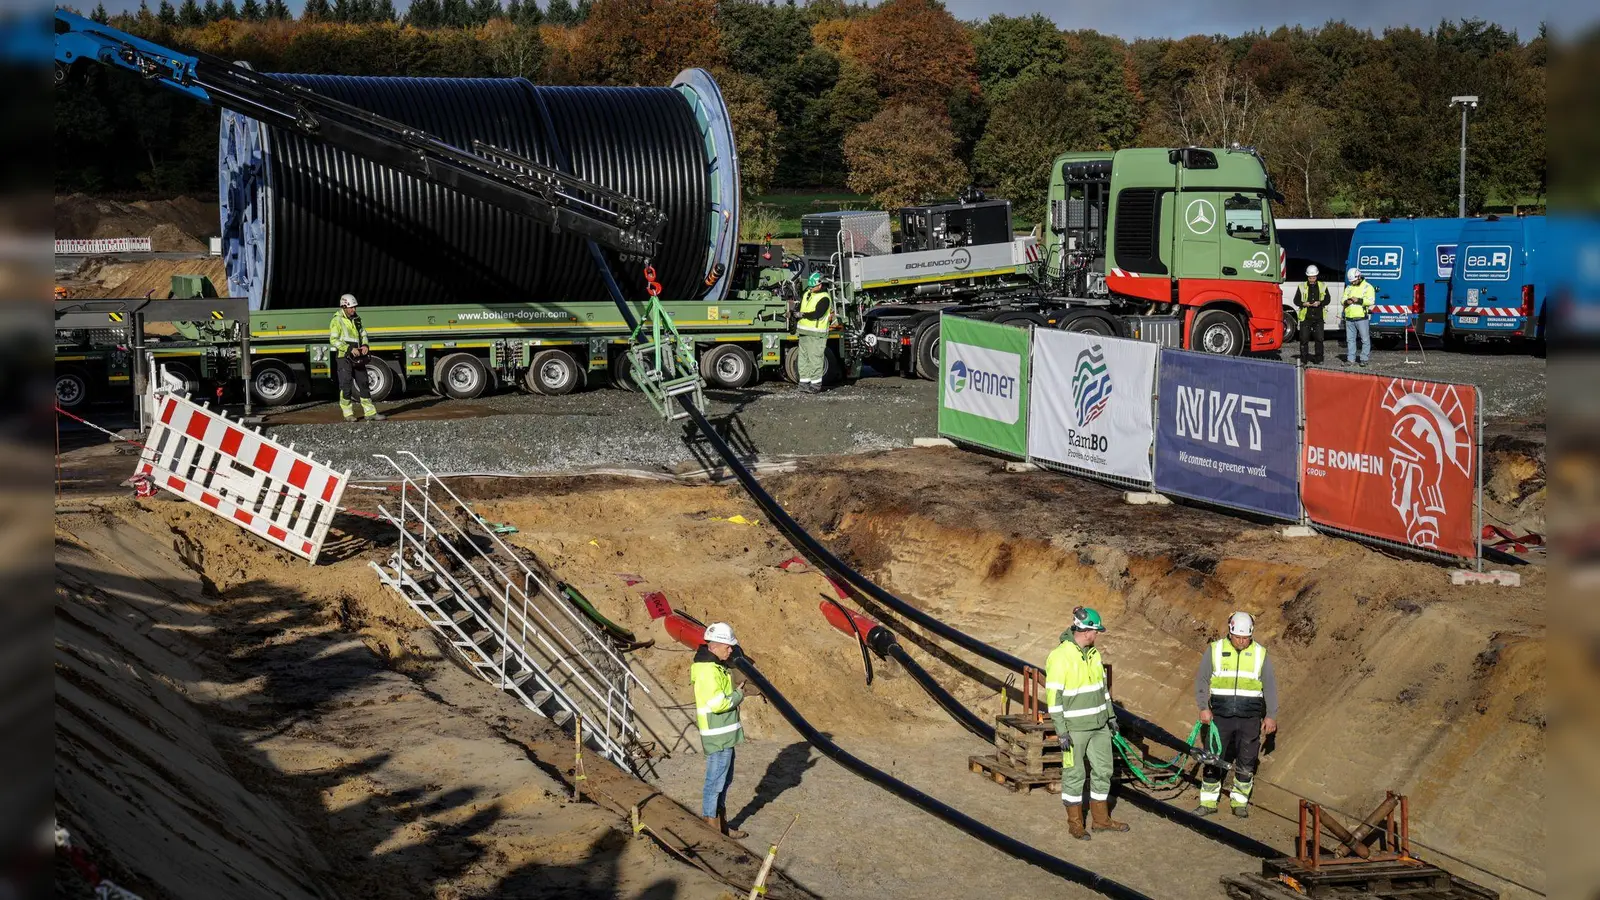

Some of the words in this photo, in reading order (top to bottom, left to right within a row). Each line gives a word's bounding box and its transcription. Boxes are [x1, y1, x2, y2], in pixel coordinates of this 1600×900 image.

[905, 258, 967, 270] BOHLENDOYEN
[1360, 252, 1398, 266] ea.R
[1440, 254, 1456, 264] ea
[1468, 252, 1506, 266] ea.R
[458, 310, 568, 320] www.bohlen-doyen.com
[1176, 385, 1270, 451] NKT
[1068, 429, 1108, 452] RamBO
[1180, 450, 1188, 462] We
[1188, 455, 1212, 468] connect
[1212, 460, 1218, 469] a
[1218, 461, 1246, 474] greener
[1246, 465, 1267, 477] world
[1308, 446, 1325, 466] DE
[1328, 449, 1383, 476] ROMEIN
[1306, 468, 1326, 477] GROUP
